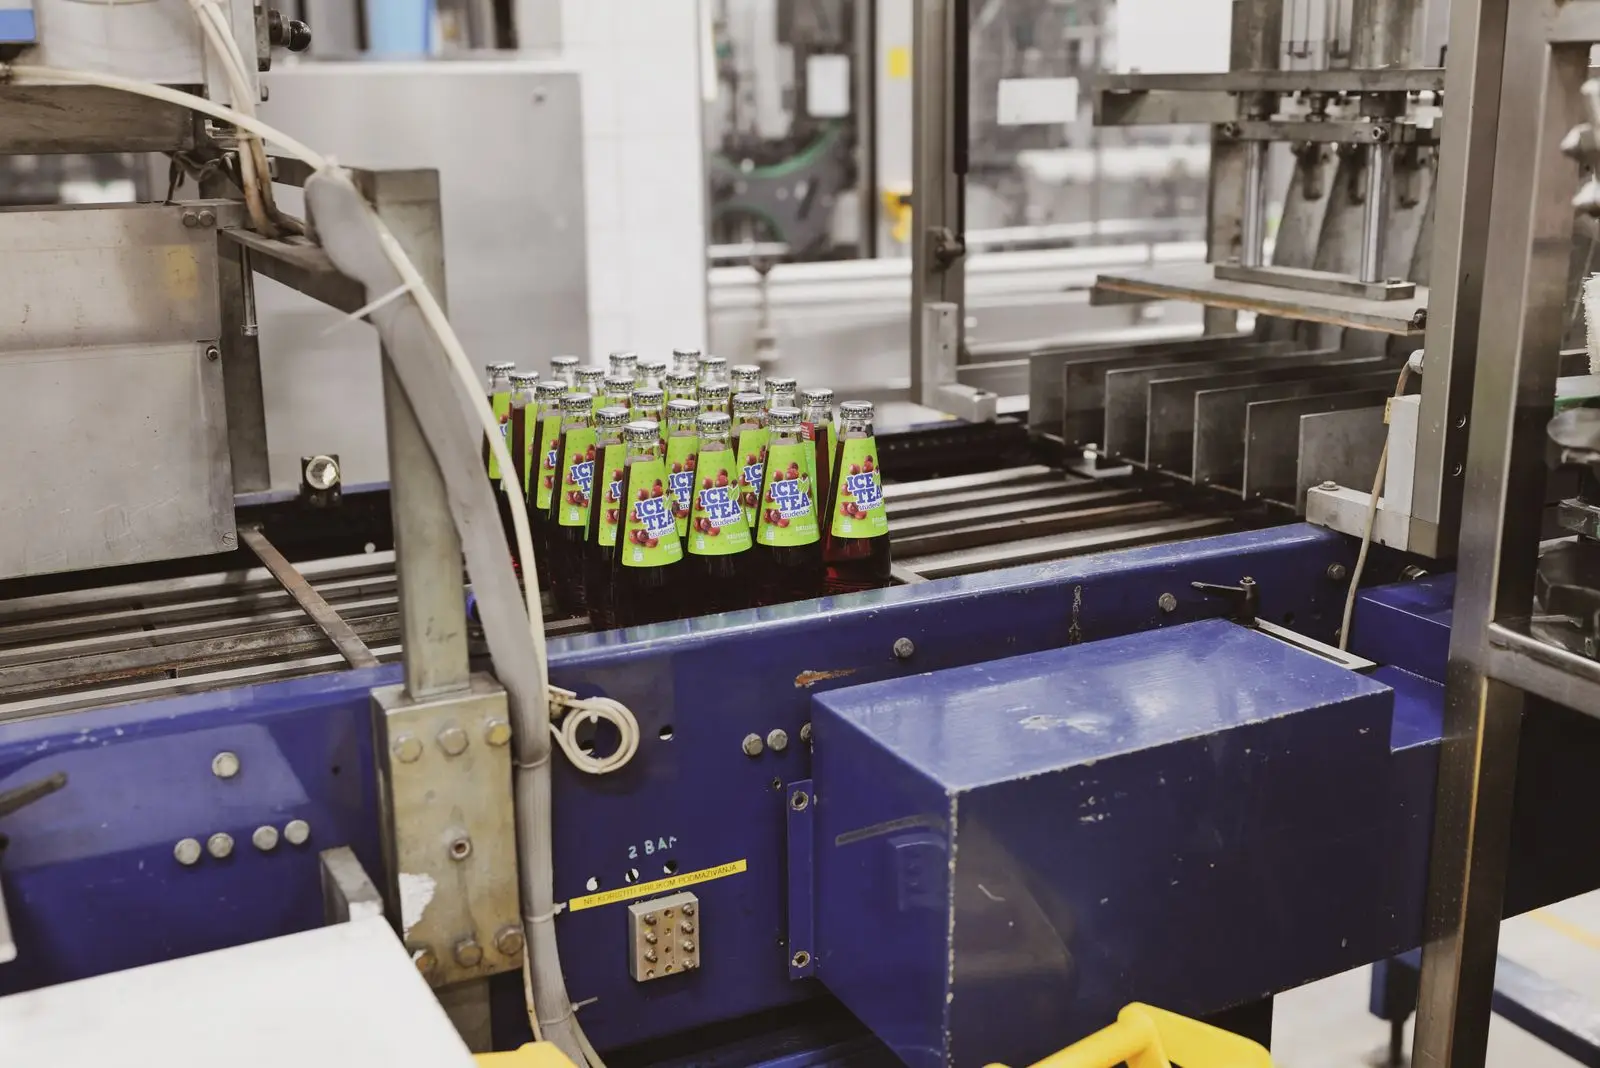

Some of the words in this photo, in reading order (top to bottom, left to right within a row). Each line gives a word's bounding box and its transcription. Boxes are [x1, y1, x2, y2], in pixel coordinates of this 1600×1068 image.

[744, 464, 762, 481] IC
[770, 480, 799, 497] ICE
[847, 473, 874, 491] ICE
[700, 488, 730, 506] ICE
[776, 493, 810, 511] TEA
[854, 485, 883, 504] TEA
[635, 498, 665, 517] ICE
[706, 500, 740, 519] TEA
[642, 510, 674, 531] TEA
[628, 845, 638, 860] 2
[639, 879, 676, 893] PRILIKOM
[679, 864, 737, 883] PODMAZIVANJA
